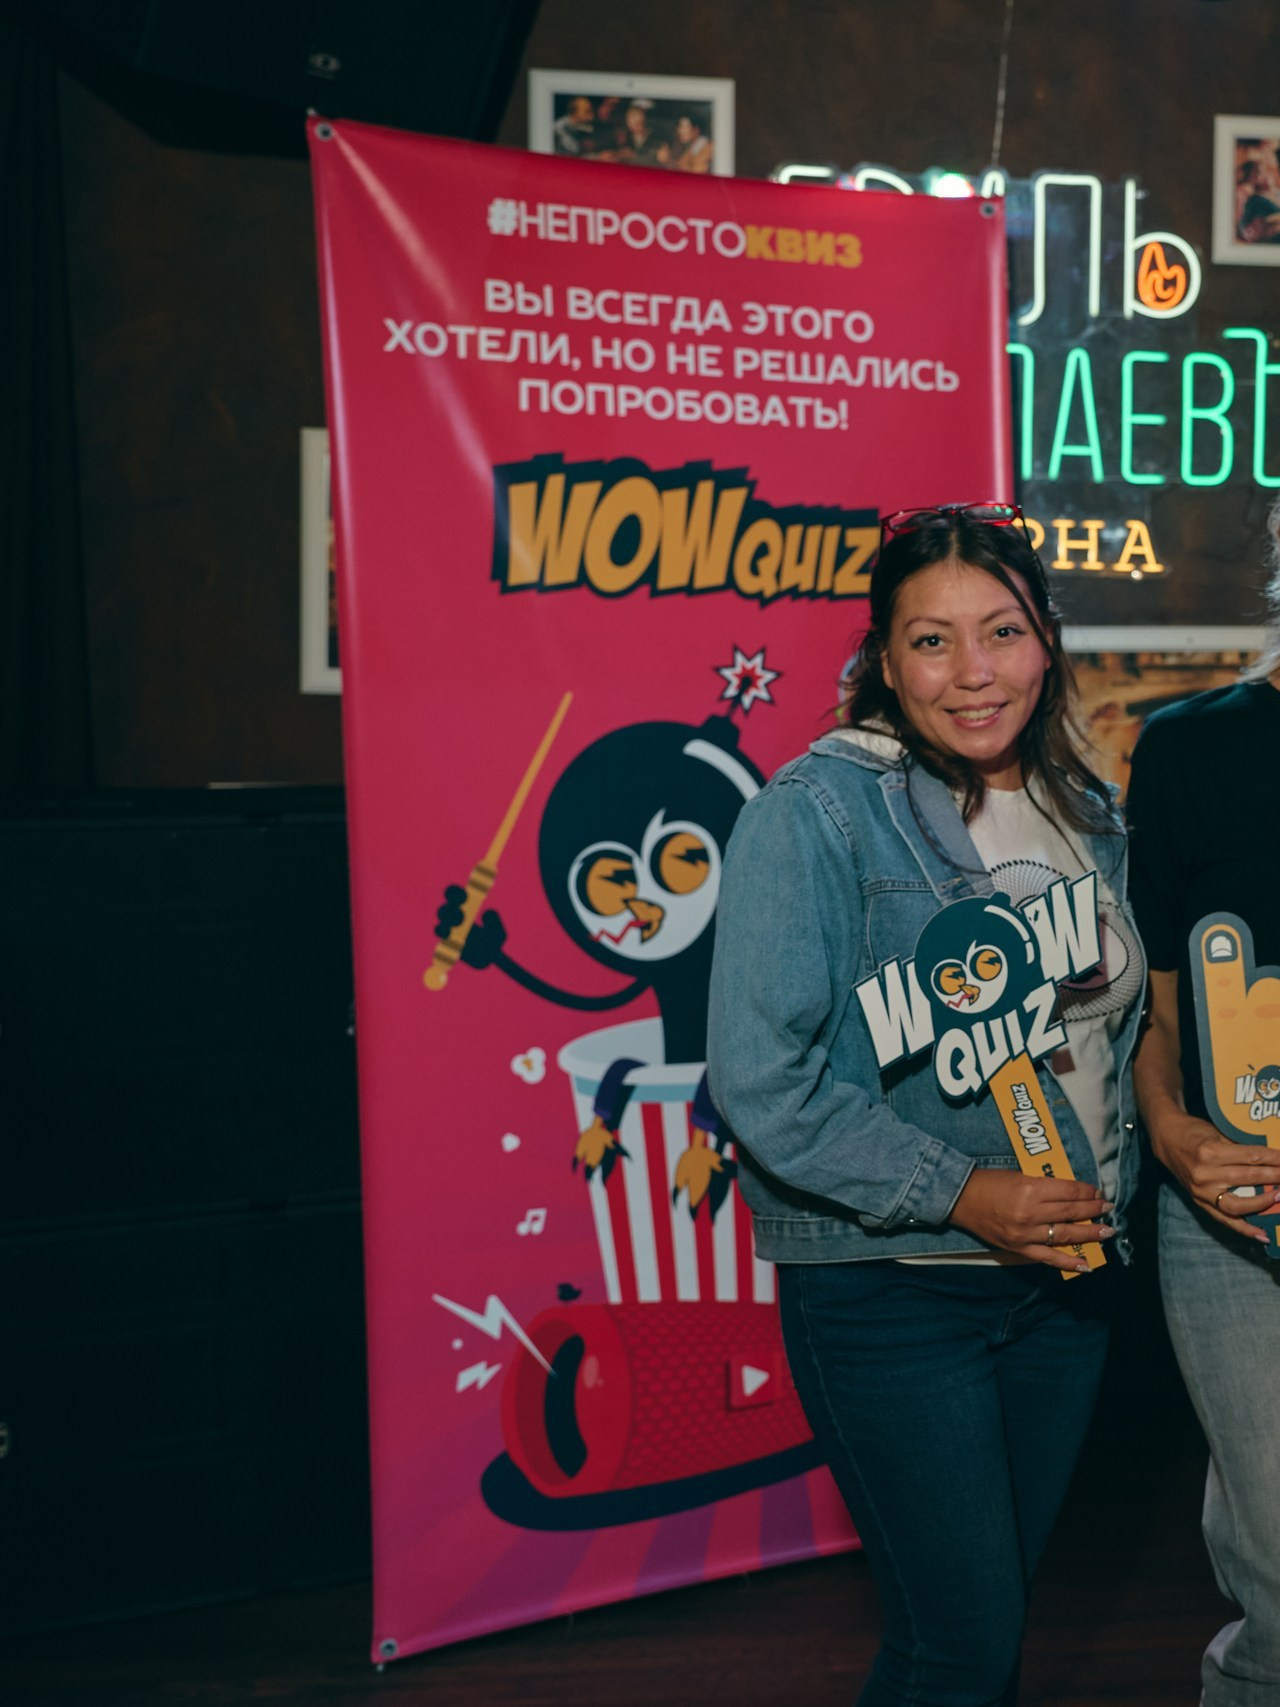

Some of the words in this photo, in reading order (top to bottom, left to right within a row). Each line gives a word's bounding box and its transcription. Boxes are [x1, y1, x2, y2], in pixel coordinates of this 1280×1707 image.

[487, 198, 863, 269] #НЕПРОСТОКВИЗ
[485, 279, 554, 318] ВЫ
[567, 287, 733, 335] ВСЕГДА
[741, 301, 875, 344] ЭТОГО
[383, 318, 582, 371] ХОТЕЛИ,
[592, 337, 655, 374] НО
[667, 344, 724, 378] НЕ
[733, 346, 961, 393] РЕШАЛИСЬ
[518, 378, 850, 431] ПОПРОБОВАТЬ!
[935, 981, 1069, 1097] QUIZ
